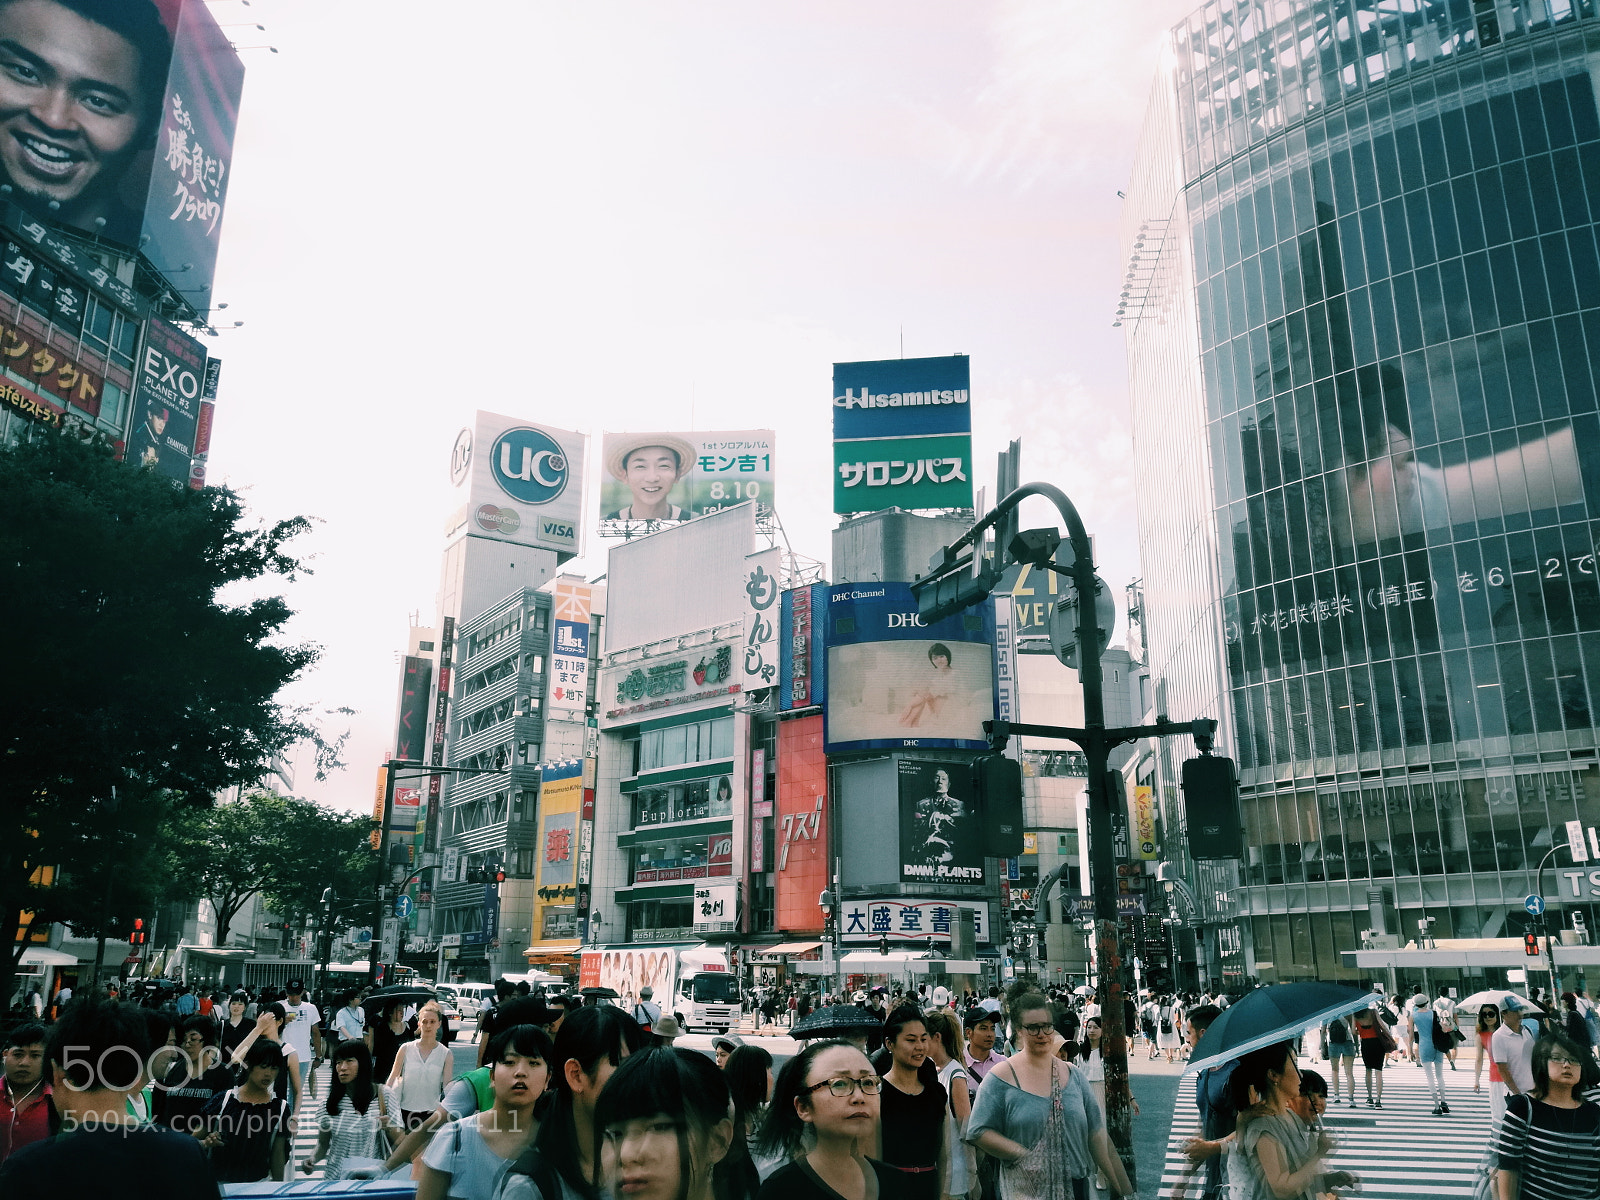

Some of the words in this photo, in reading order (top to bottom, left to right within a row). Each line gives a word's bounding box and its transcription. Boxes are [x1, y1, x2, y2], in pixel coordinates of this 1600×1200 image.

[0, 324, 97, 400] ンタクト
[144, 345, 198, 399] EXO
[145, 375, 178, 402] PLANET
[179, 397, 190, 409] #3
[833, 386, 968, 410] Hisamitsu
[702, 442, 717, 450] 1st
[720, 441, 769, 450] ソロアルバム
[838, 457, 967, 488] サロンパス
[710, 481, 760, 500] 8.10
[478, 510, 520, 526] MasterCard
[543, 522, 575, 539] VISA
[832, 591, 850, 602] DHC
[851, 588, 885, 600] Channel
[1016, 602, 1054, 626] VE
[745, 565, 777, 683] もんじゃ
[996, 618, 1012, 682] Taisei
[554, 659, 586, 673] 夜11時
[559, 672, 579, 684] まで
[565, 689, 584, 701] 地下
[903, 739, 919, 747] DHC
[641, 806, 705, 824] Euphoria
[546, 828, 571, 863] 薬
[710, 838, 732, 859] JTB
[1142, 844, 1153, 852] 4F
